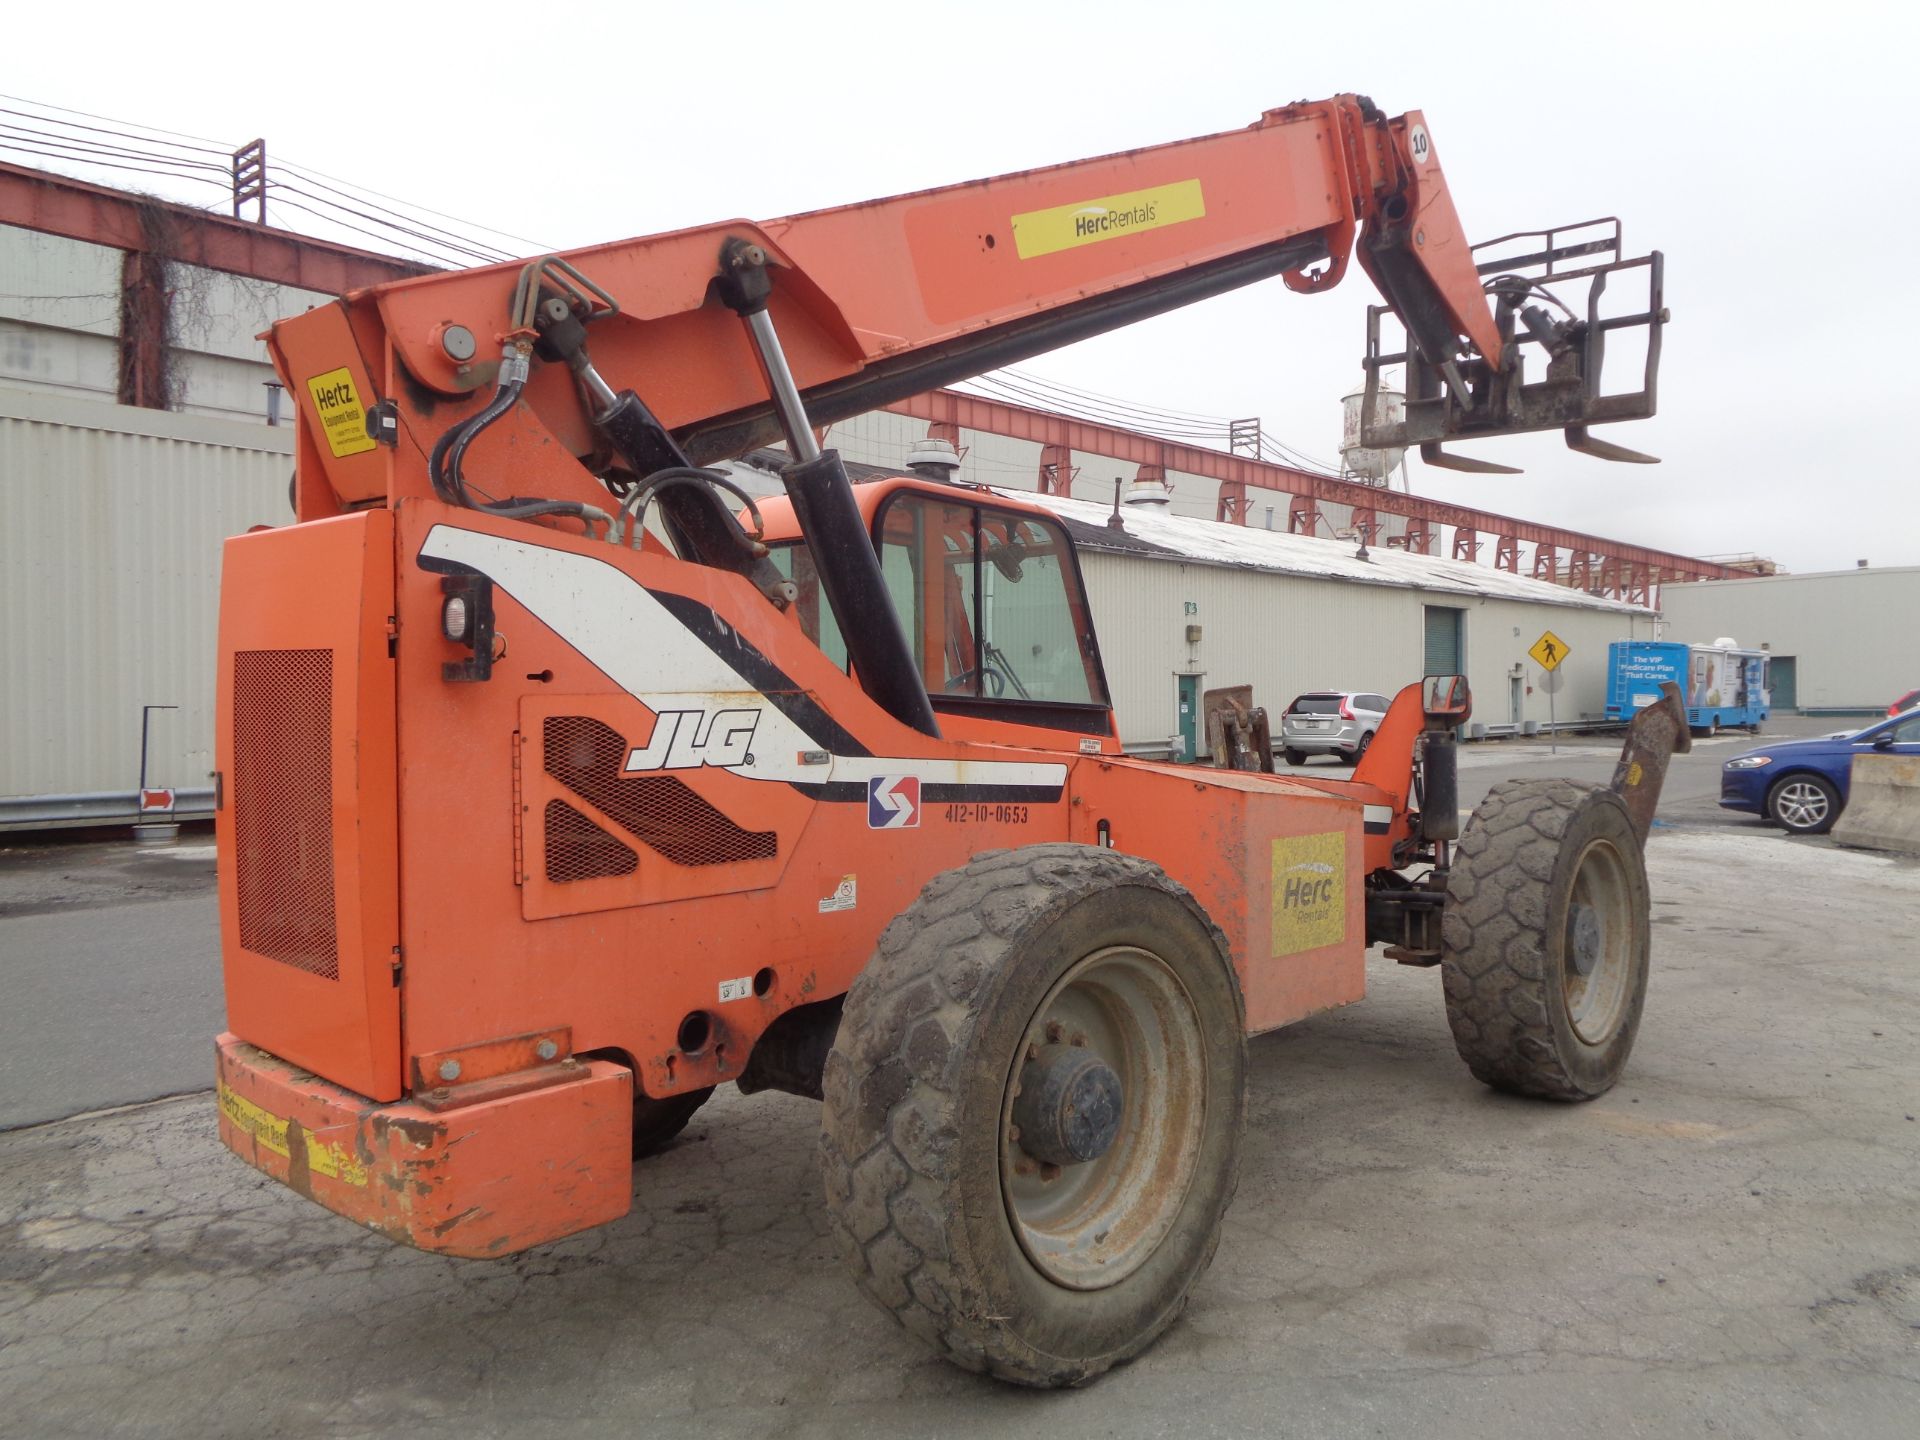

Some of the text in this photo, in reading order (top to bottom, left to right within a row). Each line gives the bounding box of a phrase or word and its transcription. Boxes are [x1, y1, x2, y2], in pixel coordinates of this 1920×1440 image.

[1413, 133, 1427, 154] 10
[1076, 203, 1156, 237] HercRentals
[316, 382, 353, 411] Hertz
[1645, 672, 1669, 680] Cares.
[624, 709, 762, 772] JLG
[945, 804, 1029, 825] 412-10-0653
[1283, 877, 1332, 909] Herc
[1297, 907, 1330, 925] Rentals
